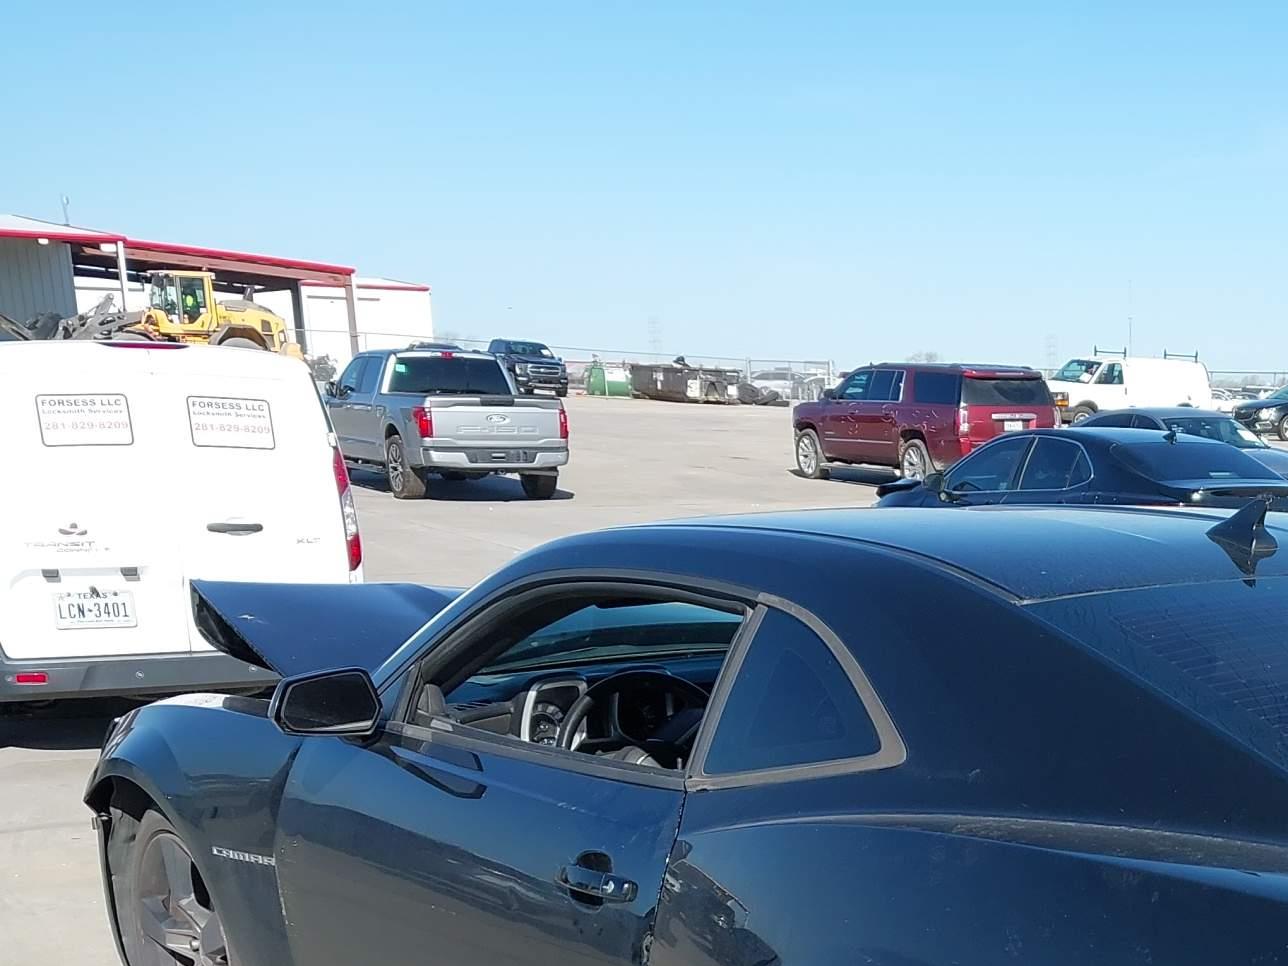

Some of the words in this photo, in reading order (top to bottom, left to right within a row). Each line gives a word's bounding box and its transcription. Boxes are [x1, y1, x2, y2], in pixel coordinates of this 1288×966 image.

[41, 399, 96, 407] FORSESS
[100, 398, 122, 406] LLC
[192, 400, 242, 410] FORSESS
[245, 403, 265, 412] LLC
[77, 592, 108, 600] TEXAS
[211, 846, 276, 866] CAMAR
